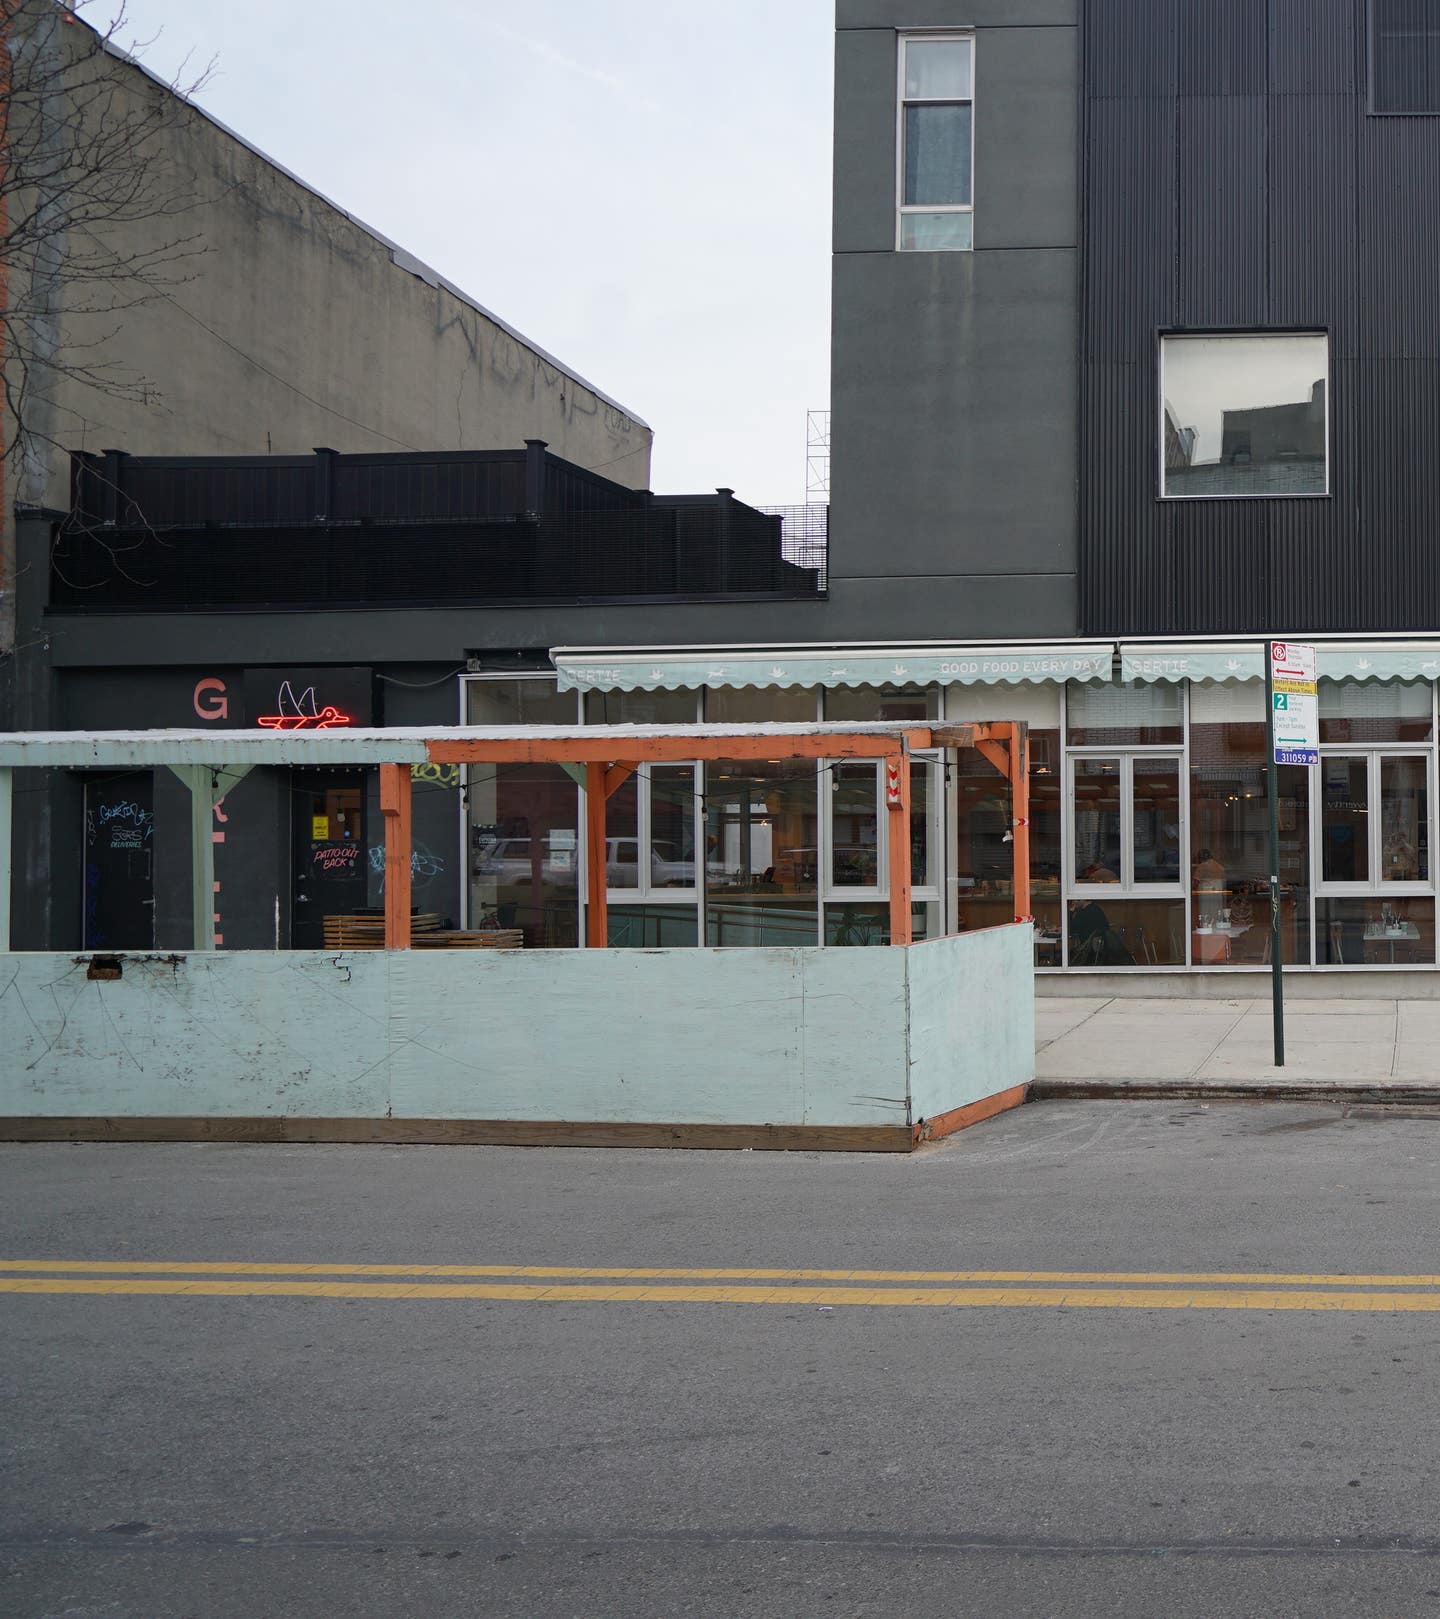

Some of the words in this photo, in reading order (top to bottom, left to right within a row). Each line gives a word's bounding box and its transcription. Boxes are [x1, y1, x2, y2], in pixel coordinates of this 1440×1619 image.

[941, 662, 978, 673] GOOD
[982, 661, 1019, 673] FOOD
[1023, 660, 1068, 672] EVERY
[1072, 659, 1102, 671] DAY
[1131, 660, 1188, 672] GERTIE
[1277, 694, 1285, 709] 2
[1281, 753, 1307, 763] 311059
[313, 848, 341, 863] PATIO
[341, 847, 360, 859] OUT
[323, 857, 348, 870] BACK
